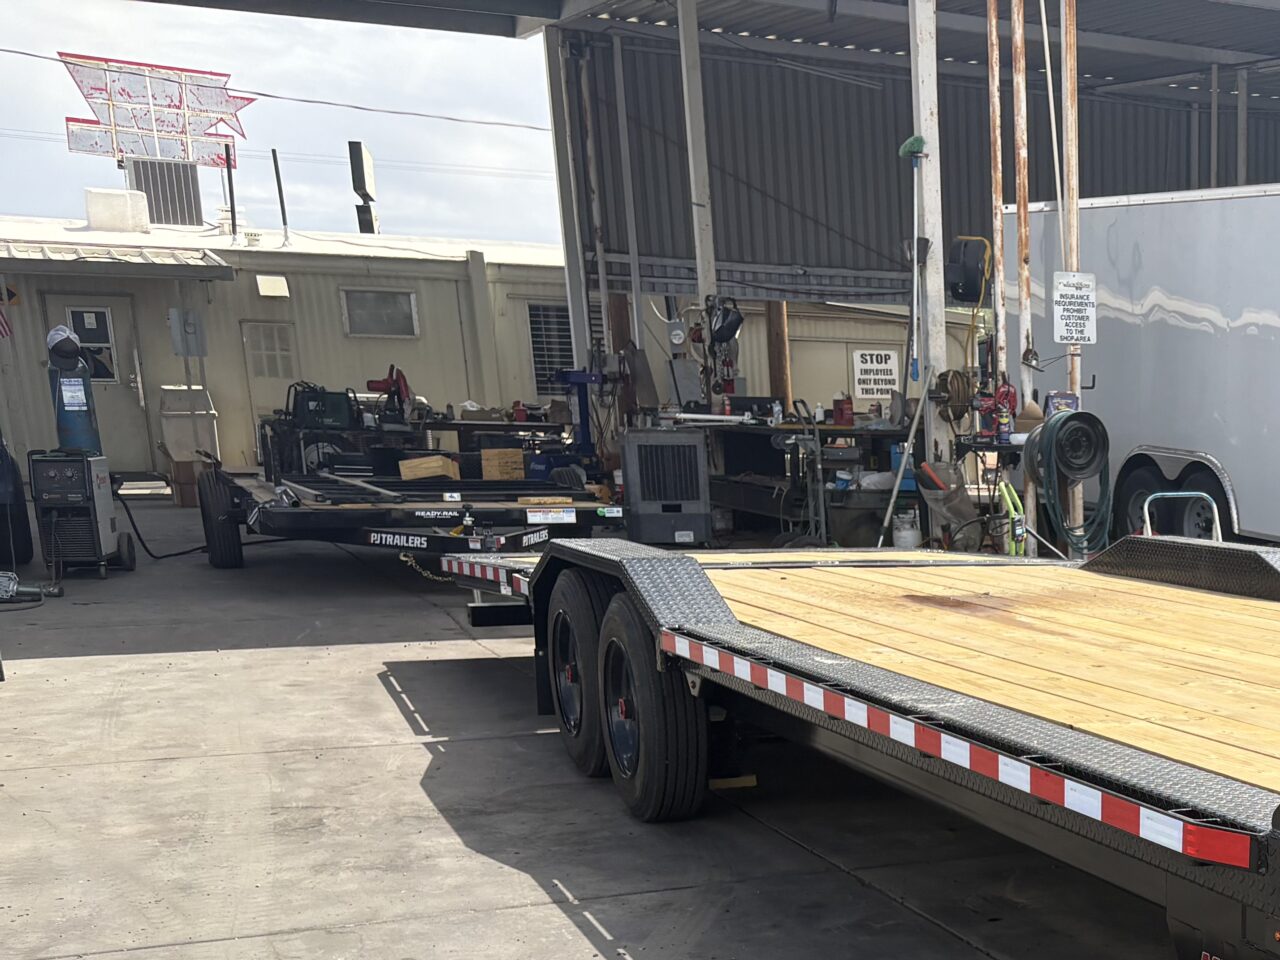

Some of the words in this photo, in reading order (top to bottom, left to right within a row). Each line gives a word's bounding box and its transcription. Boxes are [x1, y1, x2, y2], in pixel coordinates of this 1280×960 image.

[860, 353, 891, 365] STOP
[860, 368, 893, 376] EMPLOYEES
[857, 378, 872, 386] ONLY
[873, 378, 896, 386] BEYOND
[861, 387, 875, 395] THIS
[370, 532, 381, 544] PJ
[381, 533, 428, 548] TRAILERS
[528, 529, 549, 545] TRAILERS
